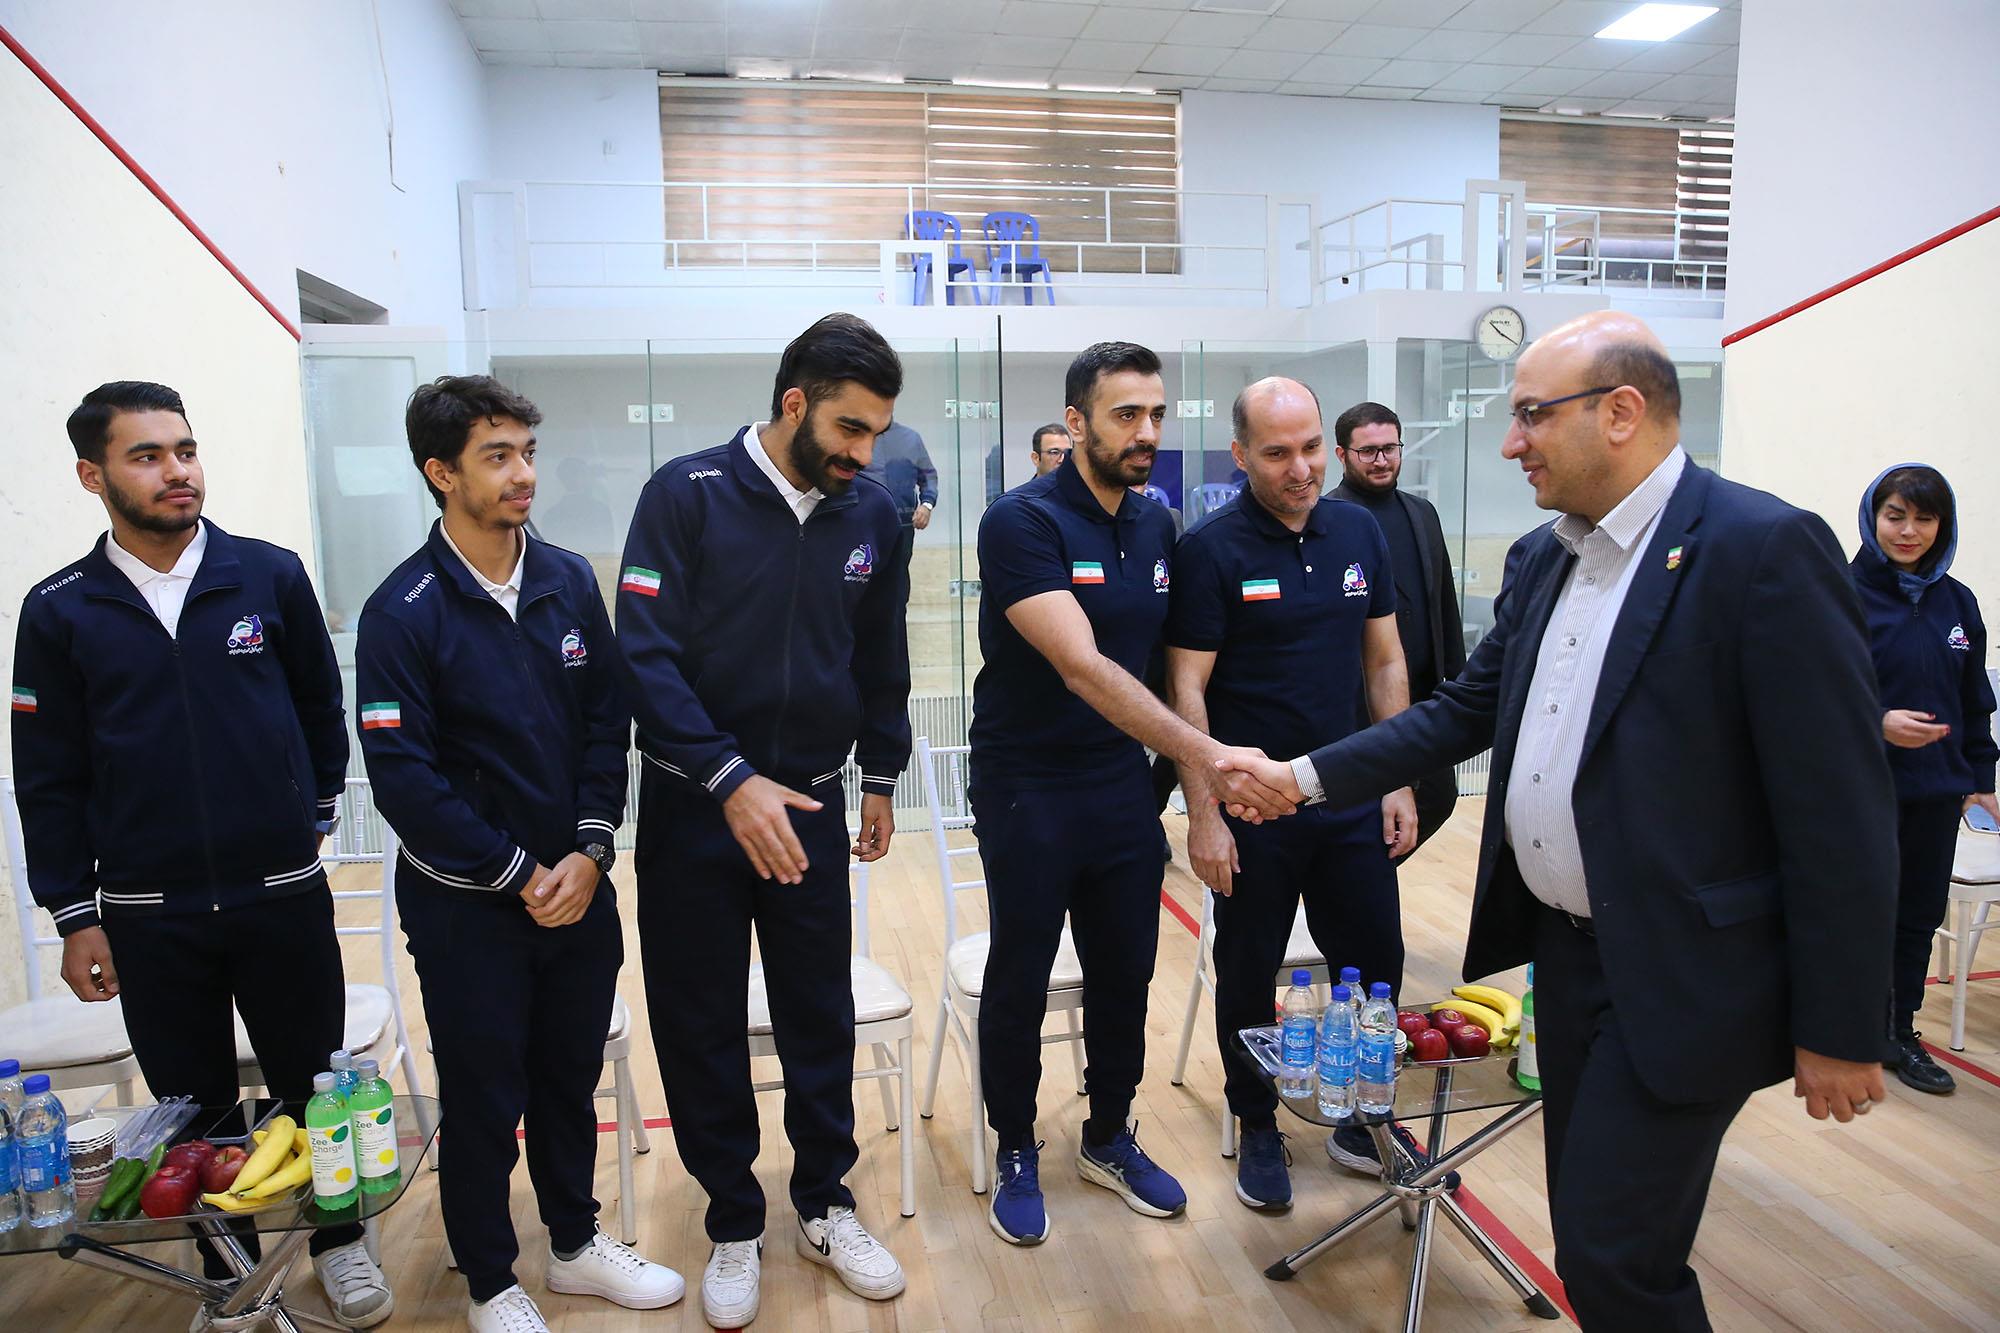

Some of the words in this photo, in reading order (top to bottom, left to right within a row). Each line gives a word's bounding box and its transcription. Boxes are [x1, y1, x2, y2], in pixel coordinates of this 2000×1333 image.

[688, 468, 723, 481] squash
[40, 571, 84, 596] squash
[404, 572, 436, 603] squash
[355, 1120, 373, 1129] Zee
[311, 1137, 328, 1146] Zee
[312, 1144, 344, 1154] Charge
